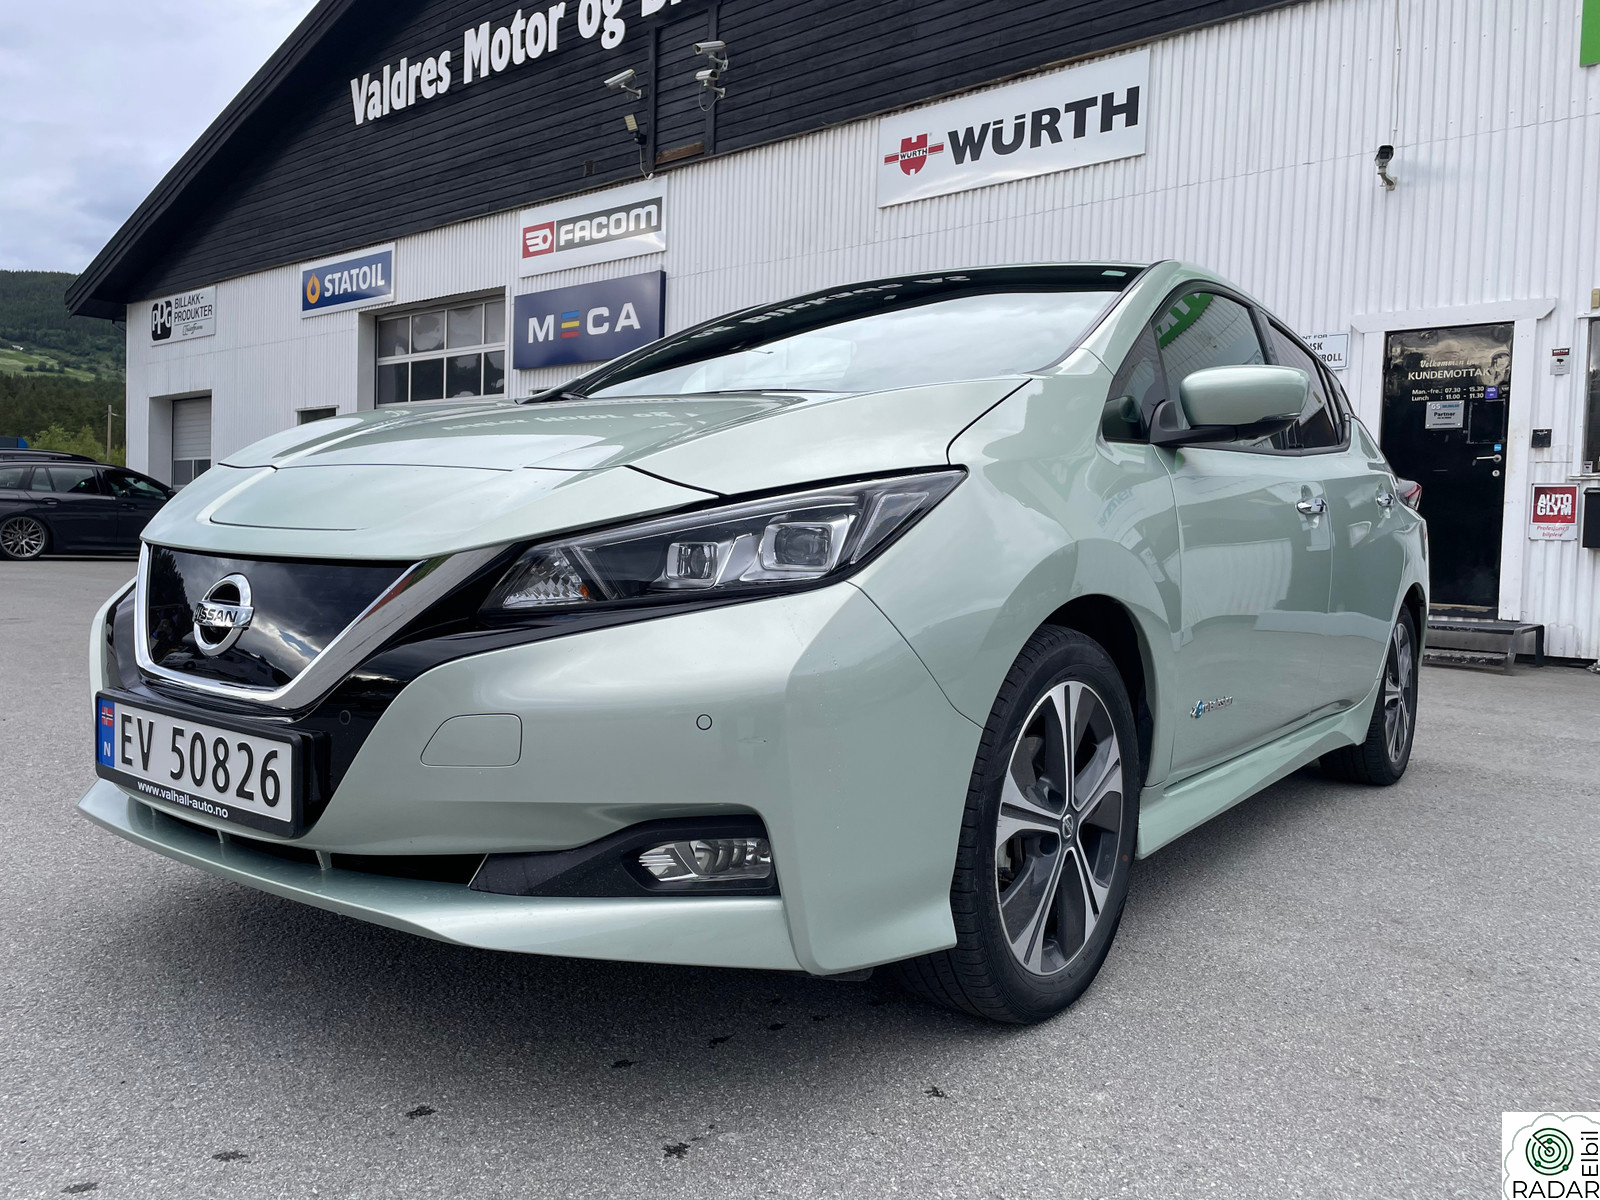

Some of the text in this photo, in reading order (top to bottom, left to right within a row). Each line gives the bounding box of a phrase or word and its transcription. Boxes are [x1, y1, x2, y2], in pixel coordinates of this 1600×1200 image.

[350, 0, 626, 126] Valdres Motor og
[947, 85, 1140, 165] WÜRTH
[558, 203, 659, 248] FACOM
[323, 261, 386, 298] STATOIL
[174, 293, 204, 309] BILLAKK-
[152, 301, 172, 334] PPG
[174, 304, 213, 322] PRODUKTER
[1310, 342, 1323, 351] SK
[1407, 367, 1490, 380] KUNDEMOTTAK
[1537, 493, 1573, 505] AUTO
[1536, 503, 1572, 516] GLYM
[195, 605, 238, 623] NISSAN
[103, 741, 111, 757] N
[120, 712, 281, 809] EV 50826
[137, 779, 230, 819] www.valhall-auto.no
